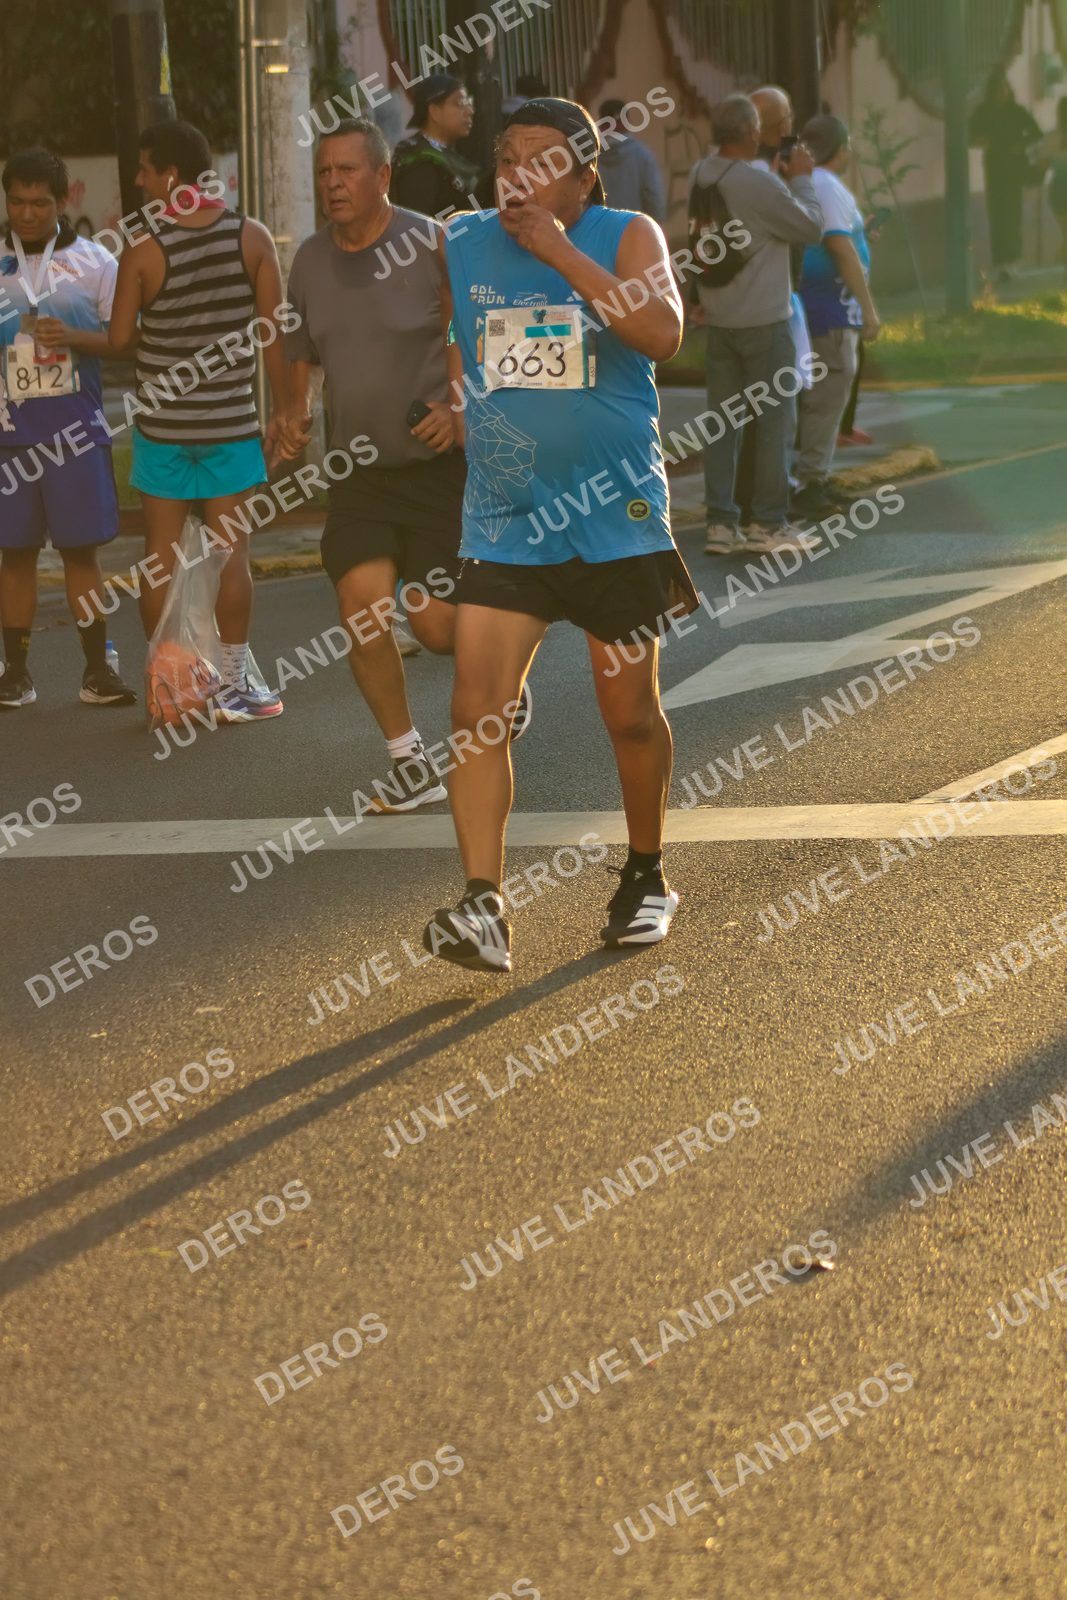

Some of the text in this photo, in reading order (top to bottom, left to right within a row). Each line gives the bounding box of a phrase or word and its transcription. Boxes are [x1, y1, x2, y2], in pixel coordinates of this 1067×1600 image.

[470, 284, 496, 295] GDL
[478, 295, 506, 305] RUN
[497, 341, 566, 379] 663
[16, 364, 64, 391] 812
